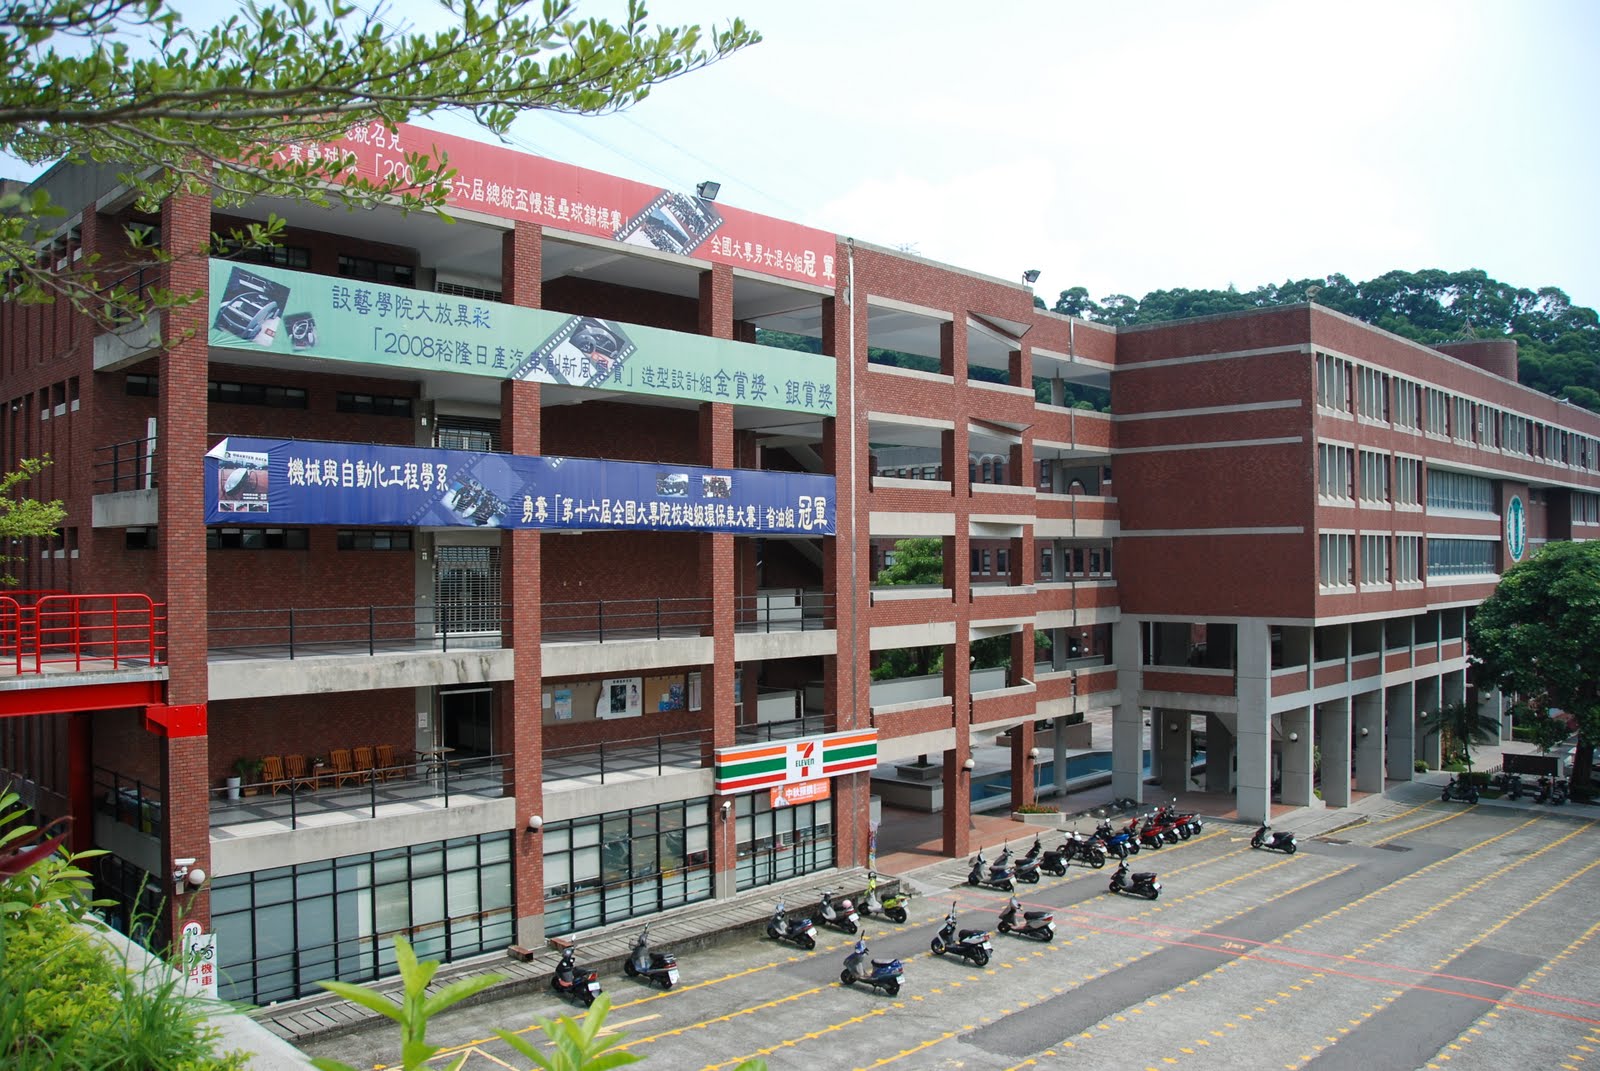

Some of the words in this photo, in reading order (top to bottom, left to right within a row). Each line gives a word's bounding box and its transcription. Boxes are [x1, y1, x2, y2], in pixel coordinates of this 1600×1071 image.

[332, 285, 491, 330] 設藝學院大放異彩
[287, 456, 449, 492] 機械與自動化工程學系
[795, 758, 815, 767] ELEVEN
